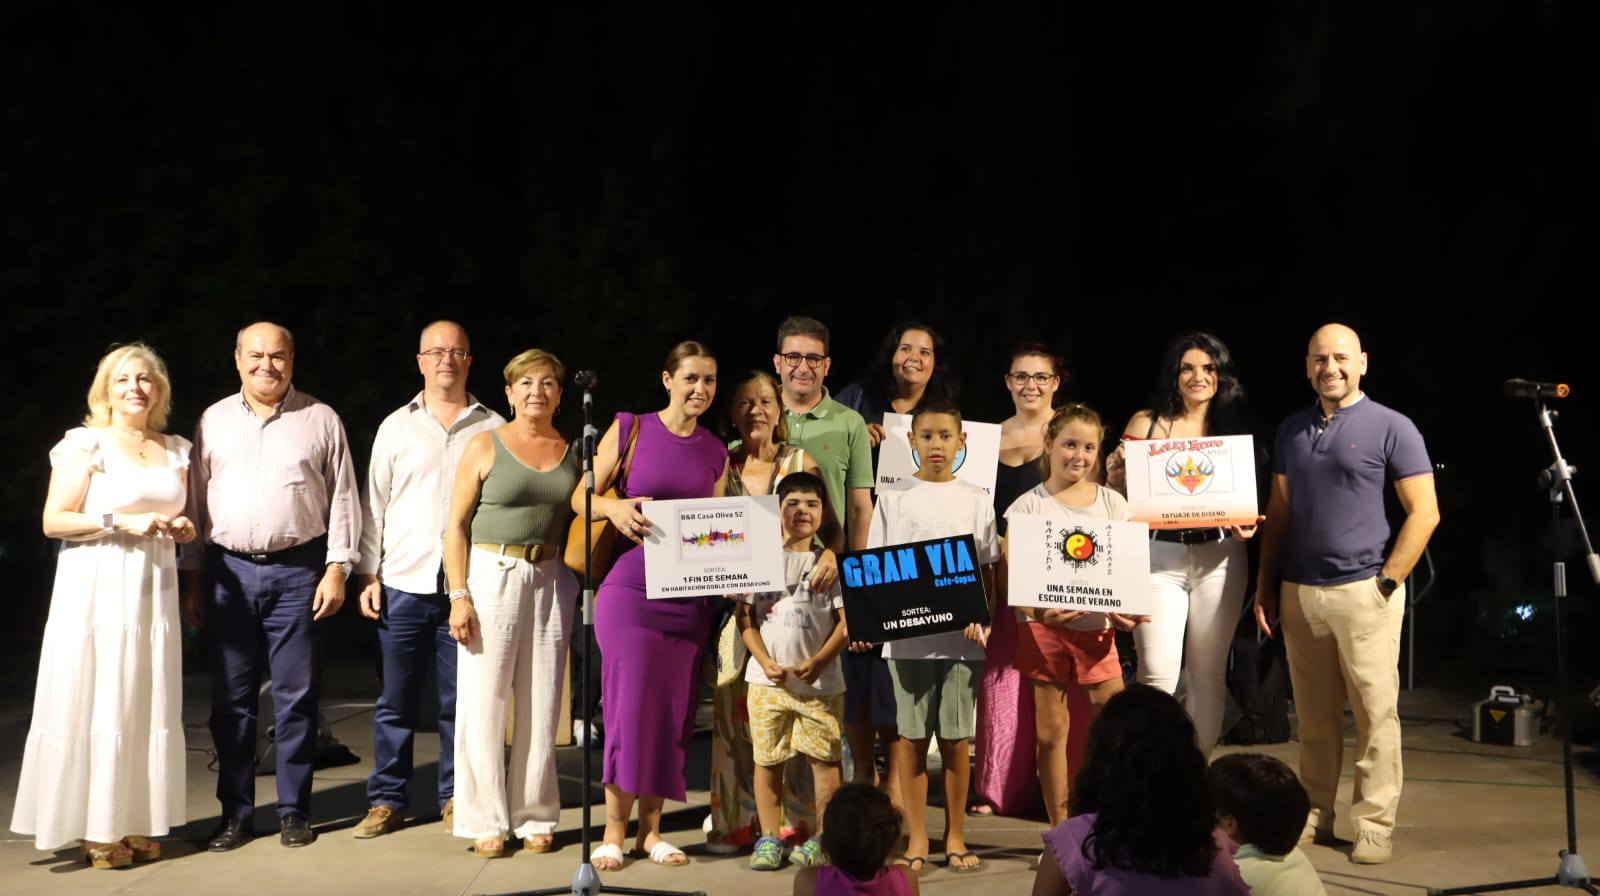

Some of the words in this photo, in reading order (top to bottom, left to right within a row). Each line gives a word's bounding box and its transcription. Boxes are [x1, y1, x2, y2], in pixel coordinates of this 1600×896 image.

[880, 476, 894, 484] UNA
[843, 547, 919, 588] GRAN
[925, 539, 975, 576] VÍA
[1047, 584, 1064, 593] UNA
[1066, 585, 1100, 596] SEMANA
[1102, 588, 1112, 596] EN
[1038, 594, 1074, 604] ESCUELA
[1076, 596, 1086, 605] DE
[1088, 598, 1122, 607] VERANO
[901, 606, 931, 617] SORTEA:
[883, 620, 898, 630] UN
[900, 612, 953, 628] DESAYUNO
